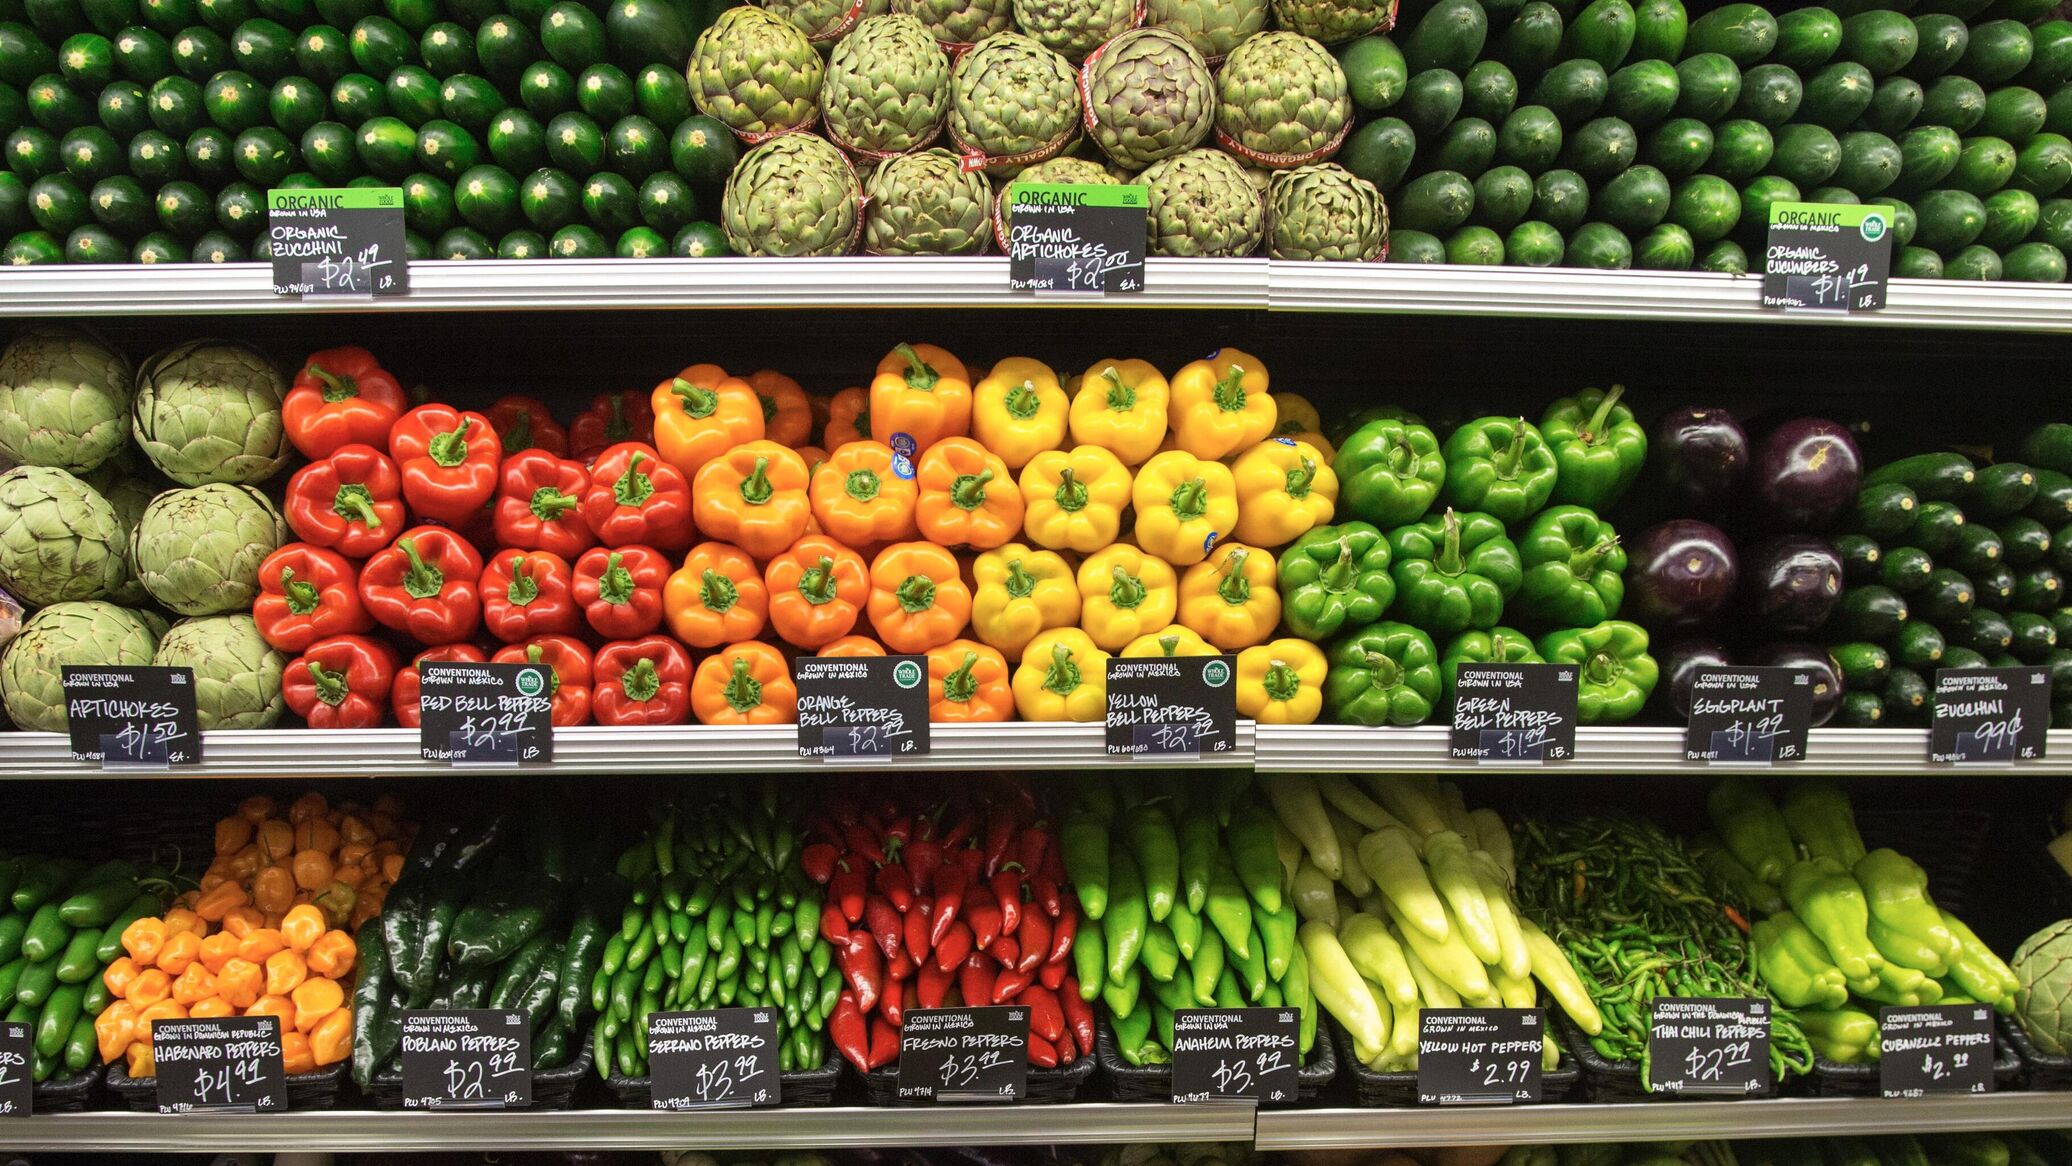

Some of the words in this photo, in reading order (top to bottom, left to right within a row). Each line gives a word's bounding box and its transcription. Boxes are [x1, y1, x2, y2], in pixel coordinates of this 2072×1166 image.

[276, 196, 345, 209] ORGANIC
[1019, 192, 1088, 206] ORGANIC
[310, 210, 327, 218] USA
[1057, 206, 1076, 214] USA
[1778, 211, 1841, 226] ORGANIC
[272, 226, 348, 241] ORGANIC
[1011, 225, 1081, 243] ORGANIC
[273, 242, 343, 257] ZUCCHINI
[1011, 242, 1108, 260] ARTICHOKES
[1767, 246, 1827, 260] ORGANIC
[1767, 260, 1840, 275] CUCUMBERS
[428, 668, 492, 677] CONVENTIONAL
[805, 663, 869, 672] CONVENTIONAL
[1115, 663, 1179, 672] CONVENTIONAL
[70, 673, 135, 682] CONVENTIONAL
[421, 676, 453, 685] GROWN
[469, 677, 504, 686] MEXICO
[797, 671, 825, 680] GROWN
[828, 671, 837, 679] IN
[838, 671, 868, 679] MEXICO
[1107, 671, 1134, 680] GROWN
[1136, 671, 1145, 679] IN
[1147, 670, 1181, 678] MEXICO
[1463, 671, 1523, 680] CONVENTIONAL
[1701, 674, 1760, 683] CONVENTIONAL
[1942, 676, 1999, 685] CONVENTIONAL
[1458, 679, 1489, 688] GROWN
[1505, 679, 1522, 688] USA
[1694, 681, 1724, 689] GROWN
[70, 699, 180, 718] ARTICHOKES
[421, 695, 452, 711] RED
[455, 695, 497, 712] BELL
[497, 695, 552, 712] PEPPERS
[797, 695, 856, 712] ORANGE
[1107, 693, 1158, 711] YELLOW
[1456, 696, 1510, 714] GREEN
[1693, 698, 1784, 715] EGGPLANT
[1935, 699, 2004, 718] ZUCCHINI
[800, 711, 838, 727] BELL
[841, 708, 903, 723] PEPPERS
[1106, 710, 1142, 728] BELL
[1143, 705, 1210, 723] PEPPERS
[1454, 712, 1493, 731] BELL
[1495, 710, 1562, 728] PEPPERS
[460, 711, 536, 750] $2.99
[848, 719, 912, 754] $2.99
[1152, 719, 1219, 752] $2.99
[1725, 713, 1791, 756] $1.99
[1974, 708, 2024, 754] 99¢
[116, 721, 187, 759] $1.50
[423, 748, 438, 759] PLU
[1659, 1003, 1717, 1012] CONVENTIONAL
[408, 1016, 470, 1025] CONVENTIONAL
[655, 1017, 718, 1026] CONVENTIONAL
[911, 1014, 973, 1024] CONVENTIONAL
[1181, 1015, 1243, 1023] CONVENTIONAL
[1426, 1016, 1487, 1025] CONVENTIONAL
[1886, 1013, 1944, 1023] CONVENTIONAL
[158, 1023, 222, 1033] CONVENTIONAL
[403, 1024, 431, 1033] GROWN
[433, 1025, 442, 1033] IN
[442, 1025, 479, 1033] MEXICO
[676, 1025, 686, 1034] IN
[904, 1022, 931, 1031] GROWN
[932, 1022, 941, 1030] IN
[943, 1020, 975, 1029] MEXICO
[1175, 1022, 1202, 1031] GROWN
[1204, 1022, 1213, 1030] IN
[1423, 1025, 1454, 1034] GROWN
[1651, 1024, 1679, 1039] THAI
[1680, 1026, 1711, 1039] CHILI
[1714, 1024, 1767, 1039] PEPPERS
[1881, 1022, 1910, 1031] GROWN
[154, 1032, 181, 1041] GROWN
[193, 1031, 230, 1040] DOMINICAN
[231, 1030, 272, 1039] REPUBLIC
[903, 1036, 958, 1051] FRESNO
[961, 1034, 1024, 1048] PEPPERS
[403, 1035, 457, 1052] POBLANO
[461, 1035, 520, 1052] PEPPERS
[649, 1039, 703, 1054] SERRANO
[704, 1033, 765, 1051] PEPPERS
[1174, 1036, 1233, 1052] ANAHEIM
[1235, 1034, 1295, 1049] PEPPERS
[1420, 1040, 1459, 1055] YELLOW
[1461, 1041, 1487, 1054] HOT
[1490, 1040, 1543, 1053] PEPPERS
[1881, 1036, 1942, 1053] CUBANELLE
[1944, 1033, 1991, 1047] PEPPERS
[155, 1045, 222, 1062] HABENARO
[225, 1041, 281, 1059] PEPPERS
[939, 1050, 1014, 1086] $3.99
[1685, 1041, 1752, 1081] $2.99
[443, 1051, 525, 1099] $2.99
[696, 1055, 764, 1101] $3.99
[1212, 1051, 1291, 1094] $3.99
[194, 1058, 267, 1103] $4.99
[899, 1087, 913, 1097] PLU
[1421, 1094, 1436, 1102] PLU
[404, 1098, 418, 1107] PLU
[654, 1099, 668, 1109] PLU
